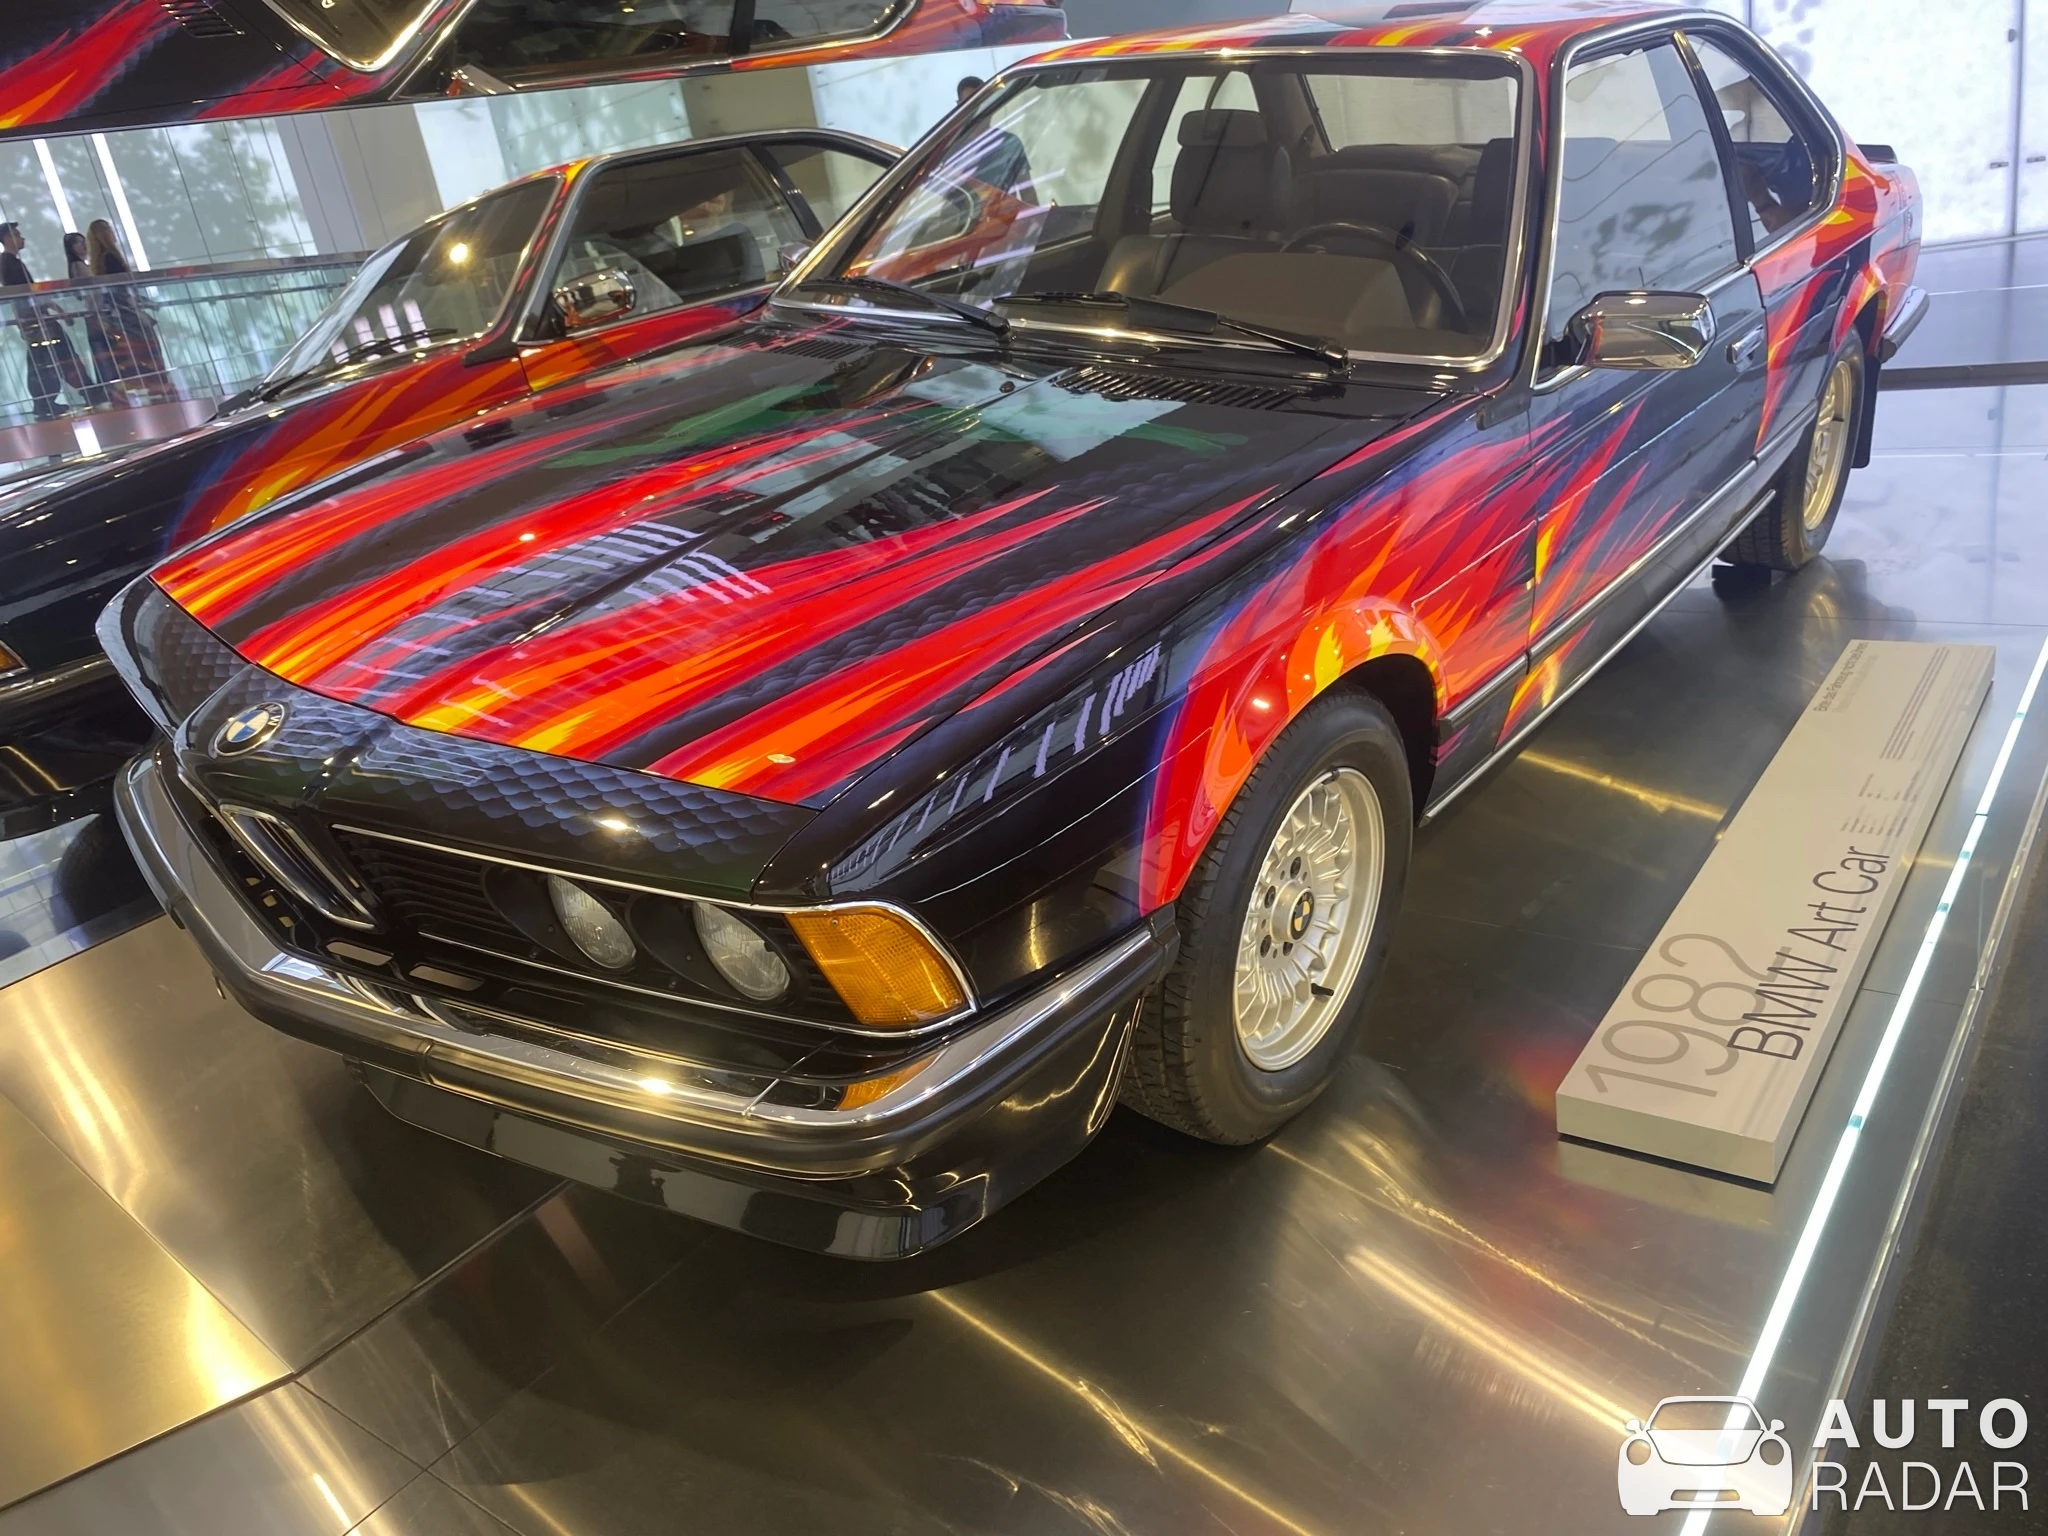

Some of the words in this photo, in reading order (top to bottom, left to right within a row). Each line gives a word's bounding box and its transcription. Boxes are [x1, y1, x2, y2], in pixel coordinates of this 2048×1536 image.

[1812, 845, 1890, 895] Car
[1787, 901, 1867, 952] Art
[1585, 934, 1791, 1097] 1982
[1727, 951, 1838, 1060] BMW
